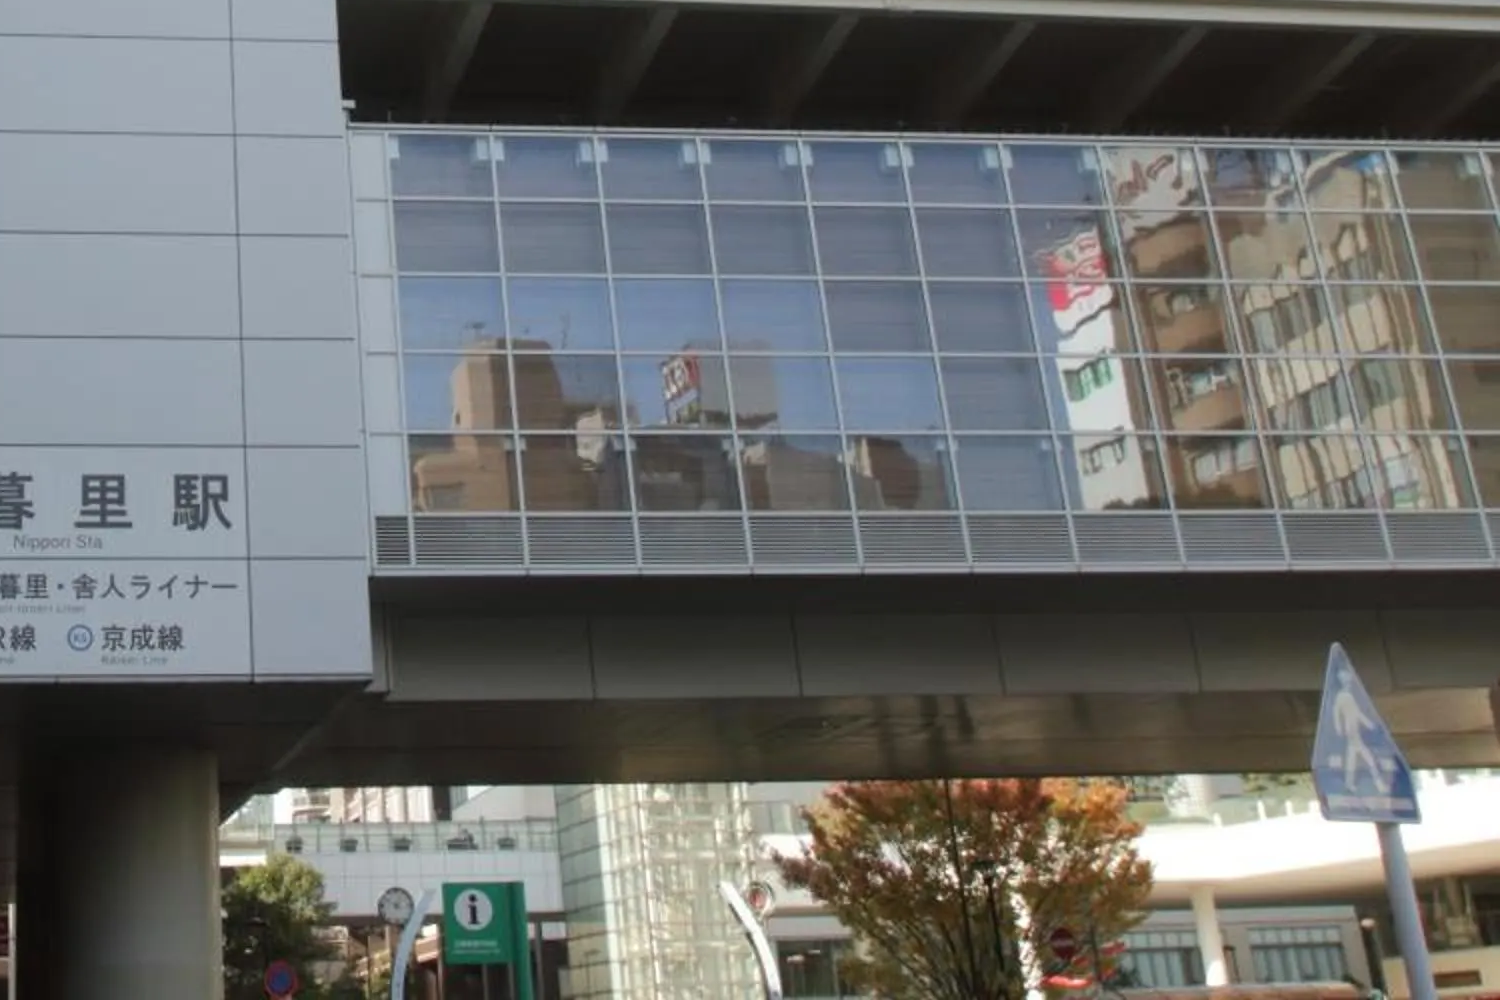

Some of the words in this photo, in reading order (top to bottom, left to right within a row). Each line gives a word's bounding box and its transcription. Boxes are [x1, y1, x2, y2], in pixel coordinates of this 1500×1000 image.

[13, 536, 70, 551] Nippori
[75, 535, 104, 549] Sta
[101, 624, 185, 651] 京成線
